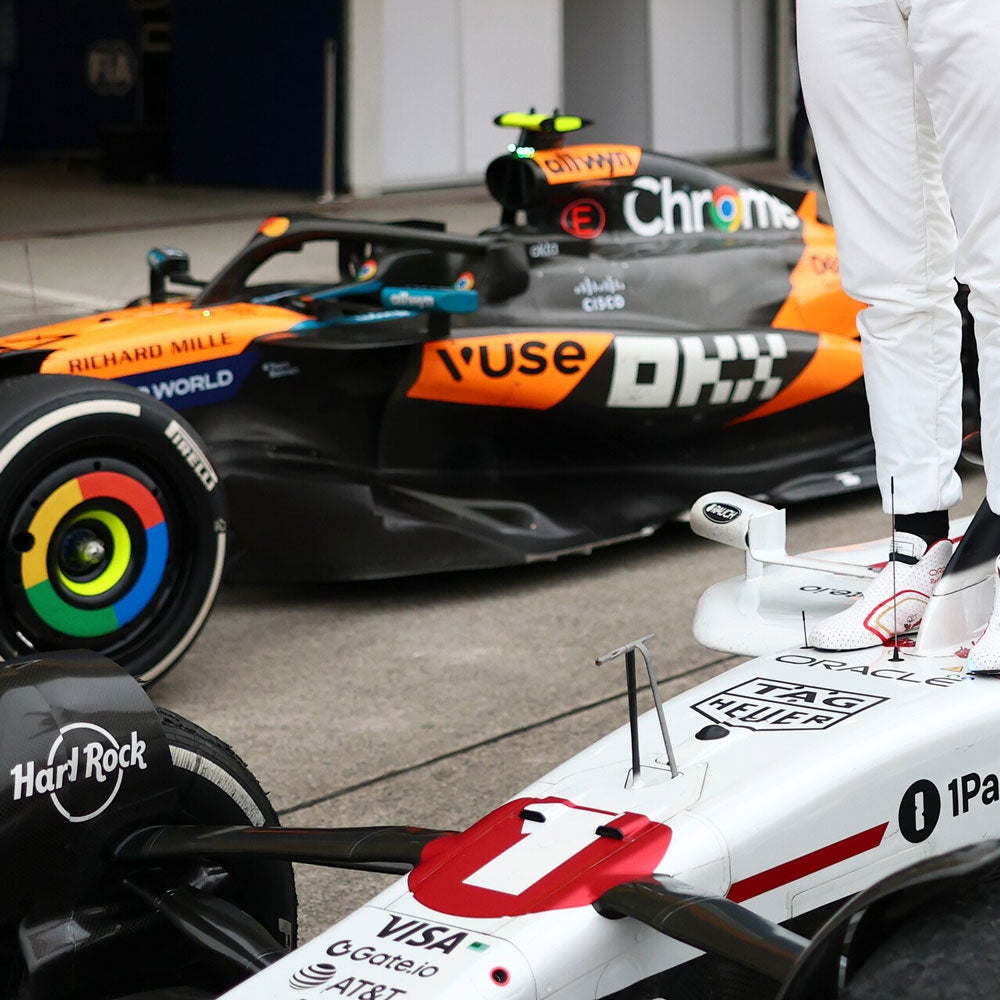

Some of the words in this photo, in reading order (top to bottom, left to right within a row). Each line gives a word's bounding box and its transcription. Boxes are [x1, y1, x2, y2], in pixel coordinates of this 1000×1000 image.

[545, 149, 634, 178] allwyn
[623, 176, 799, 237] Chrome
[69, 343, 163, 373] RICHARD
[171, 331, 233, 353] MILLE
[152, 369, 234, 400] WORLD
[164, 419, 219, 491] PIRELLI
[775, 655, 962, 687] ORACLE
[709, 699, 834, 724] HEUER
[753, 683, 866, 709] TAG
[10, 747, 79, 800] Hard
[83, 731, 147, 782] Rock
[461, 802, 625, 896] 1
[376, 914, 469, 954] VISA
[350, 946, 440, 978] Gate.io
[324, 976, 407, 1000] AT&T
